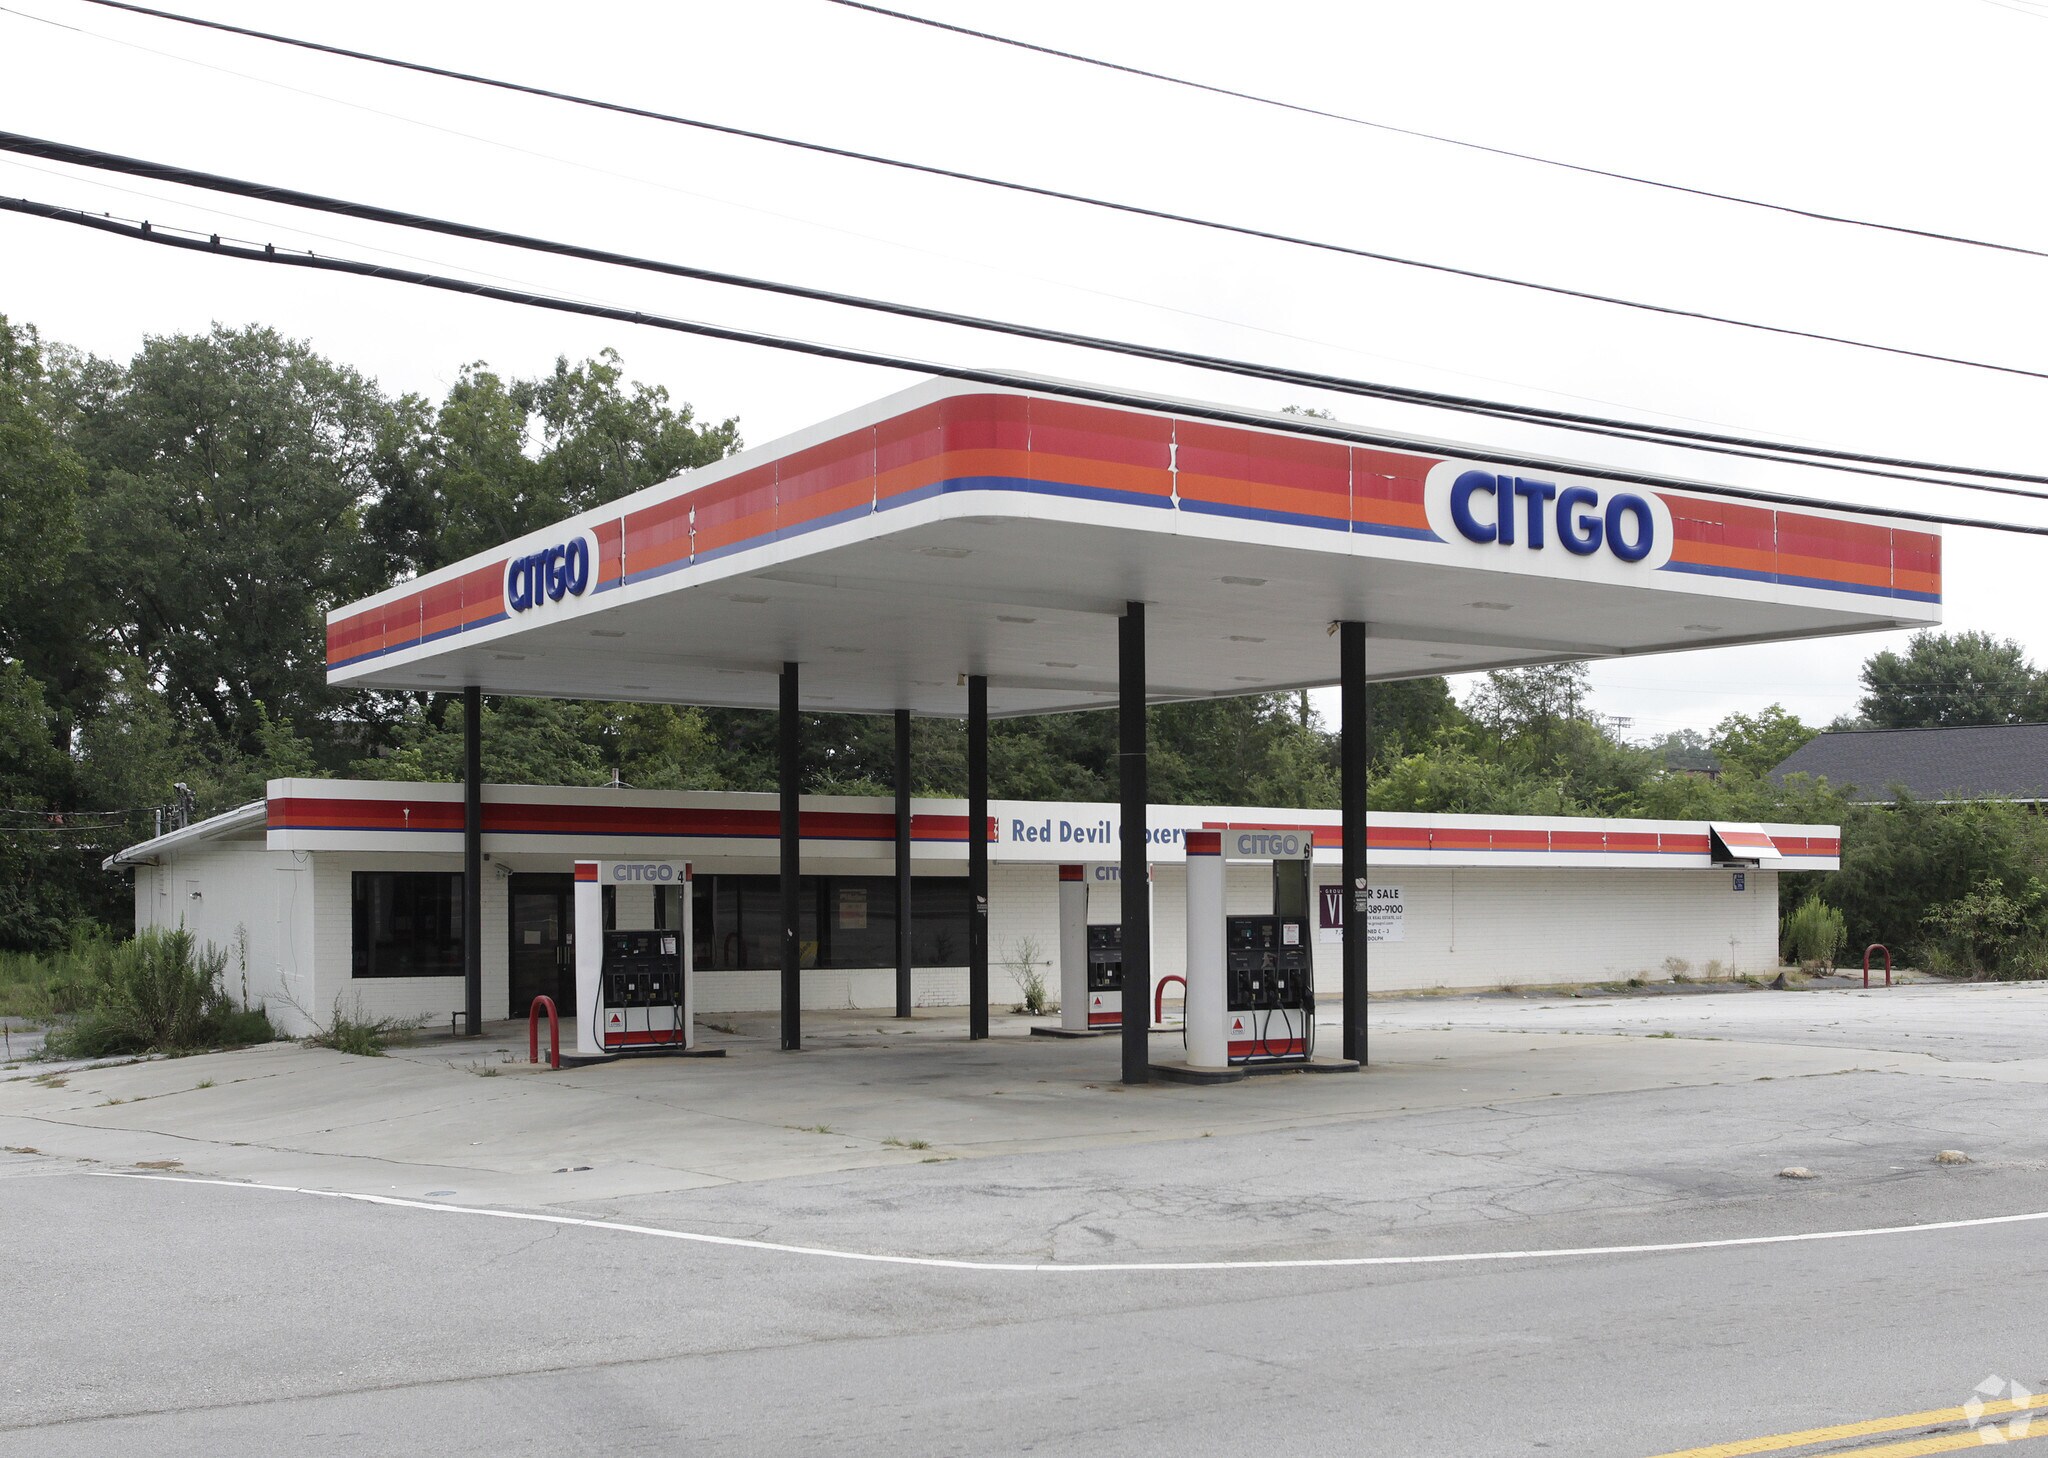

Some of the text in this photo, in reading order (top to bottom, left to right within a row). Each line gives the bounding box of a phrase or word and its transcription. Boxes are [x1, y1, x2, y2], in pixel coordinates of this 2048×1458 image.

[1450, 470, 1653, 562] CITGO
[508, 536, 589, 613] CITGO
[1012, 819, 1051, 843] Red
[1059, 820, 1111, 844] Devil
[1237, 834, 1299, 855] CITGO
[612, 864, 673, 881] CITGO
[677, 870, 684, 883] 4
[1095, 866, 1121, 881] CIT
[1376, 889, 1399, 899] SALE
